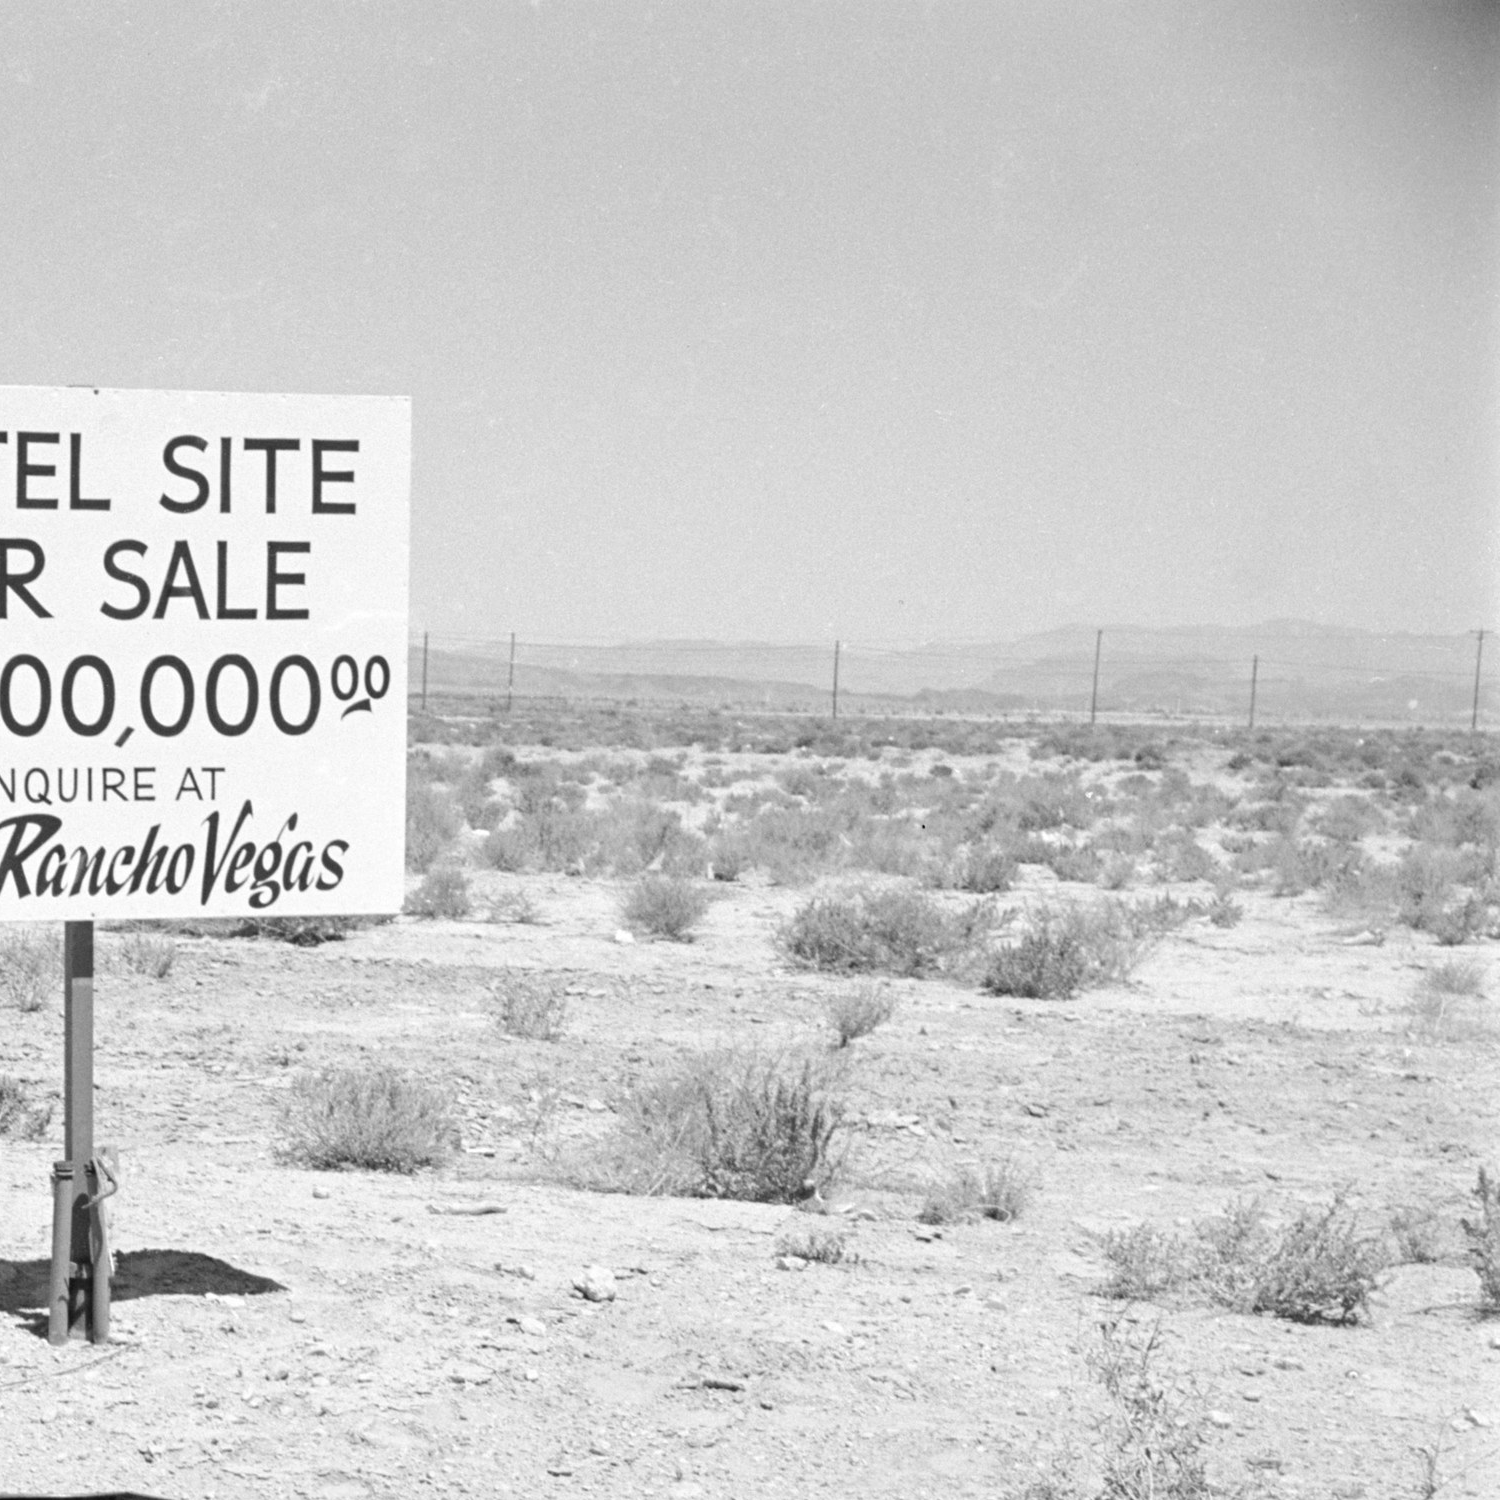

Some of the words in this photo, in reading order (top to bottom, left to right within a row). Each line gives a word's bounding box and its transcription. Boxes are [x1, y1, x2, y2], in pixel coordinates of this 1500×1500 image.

[159, 435, 360, 515] SITE
[100, 539, 311, 621] SALE
[176, 767, 225, 801] AT
[200, 800, 349, 908] Vegas
